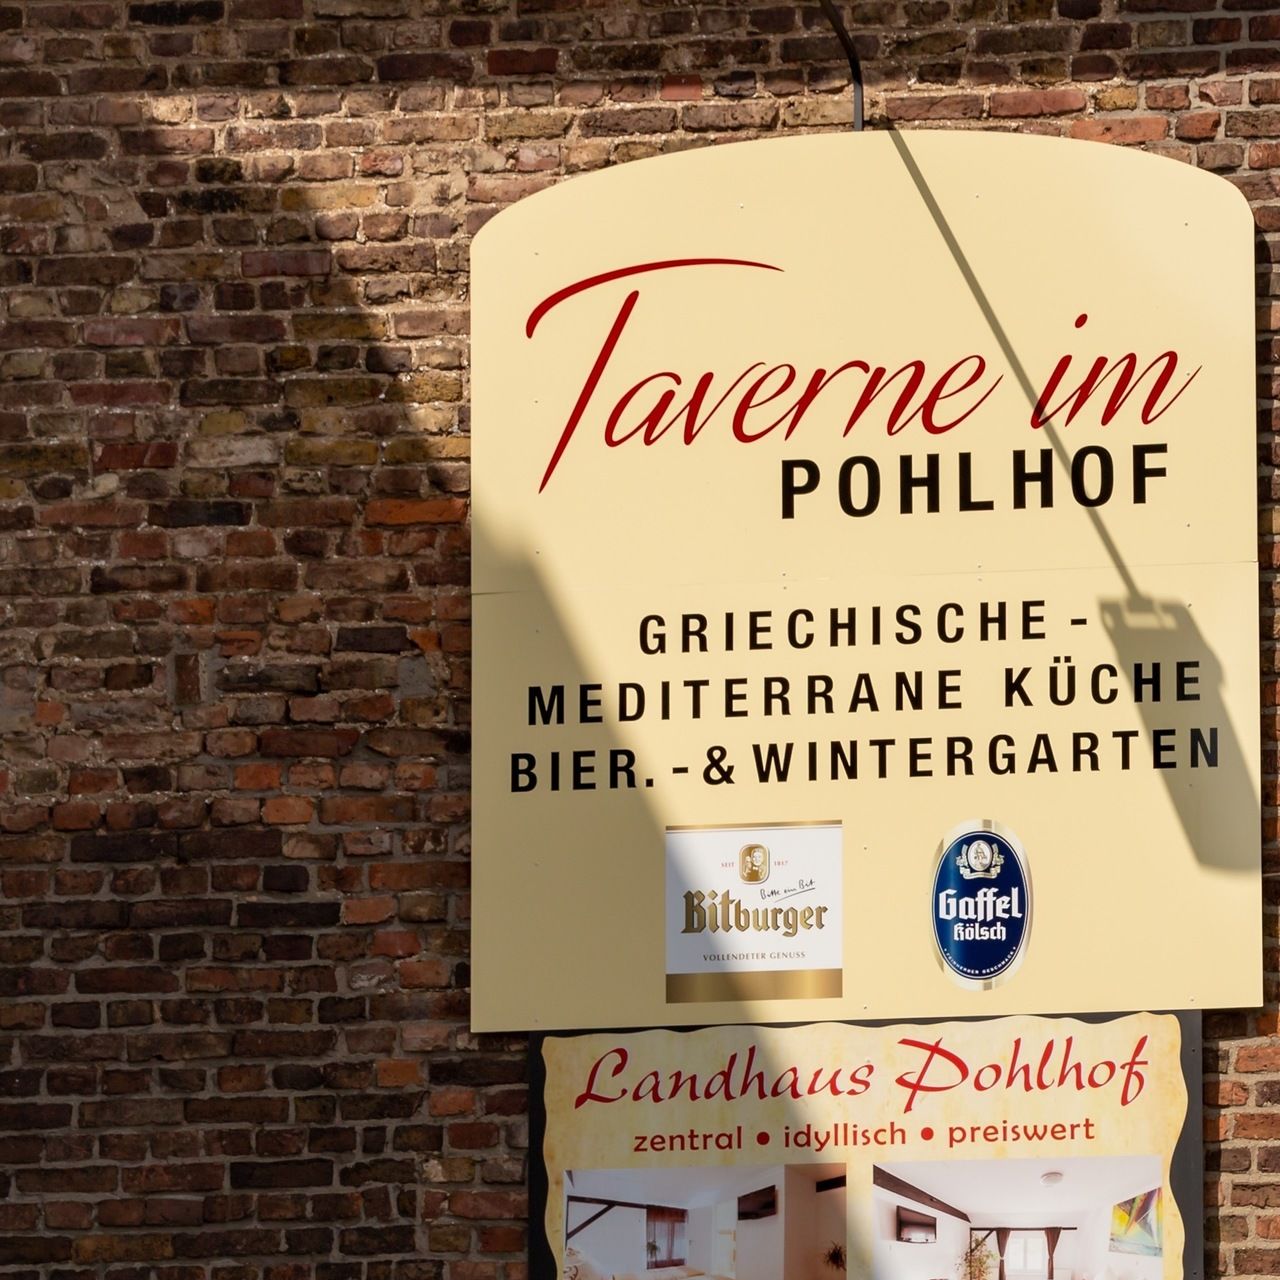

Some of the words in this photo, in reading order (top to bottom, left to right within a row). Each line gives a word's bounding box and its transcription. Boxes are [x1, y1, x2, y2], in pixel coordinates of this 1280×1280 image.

[526, 258, 1003, 495] Taverne
[1030, 313, 1202, 430] im
[780, 444, 1169, 520] POHLHOF
[527, 669, 963, 726] MEDITERRANE
[1004, 655, 1201, 707] KÜCHE
[681, 889, 829, 938] Bitburger
[938, 886, 1023, 922] Gaffel
[953, 921, 1007, 942] Kölsch
[703, 952, 766, 962] VOLLENDETER
[769, 951, 806, 960] GENUSS
[574, 1045, 874, 1111] Landhaus
[895, 1035, 1149, 1114] Pohlhof
[633, 1125, 743, 1152] zentral
[783, 1122, 907, 1150] idyllisch
[948, 1118, 1095, 1148] preiswert
